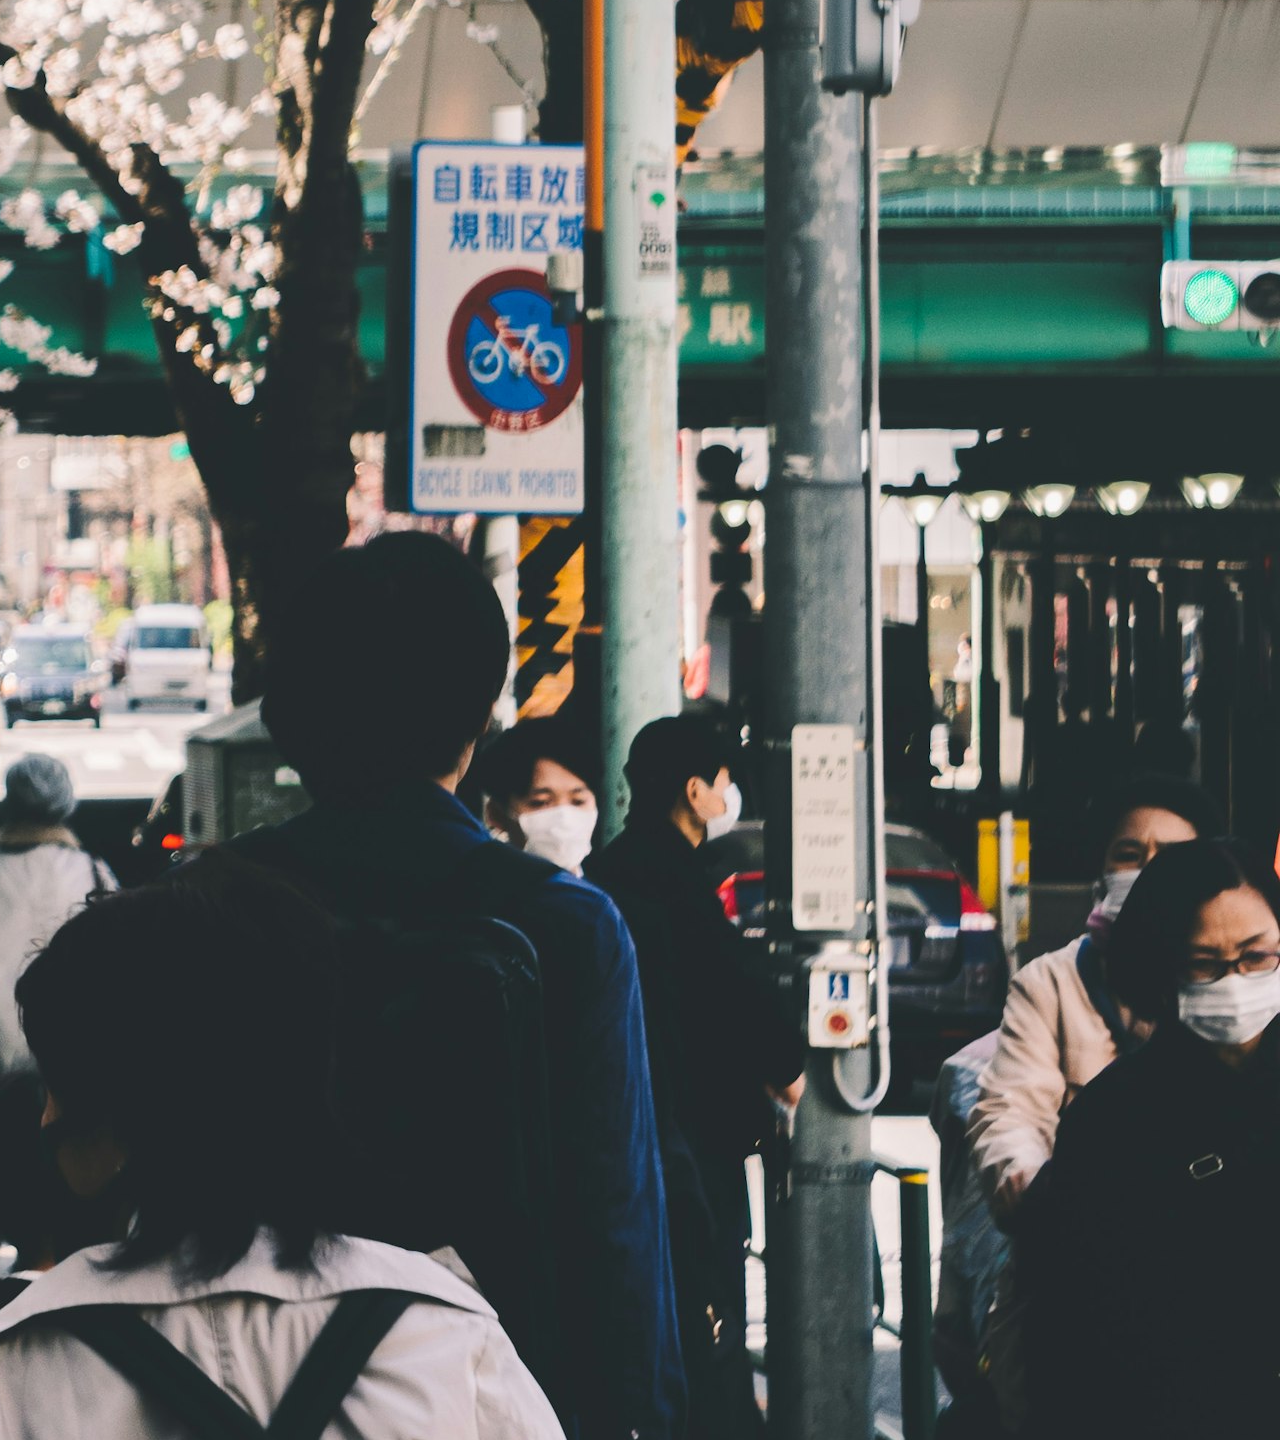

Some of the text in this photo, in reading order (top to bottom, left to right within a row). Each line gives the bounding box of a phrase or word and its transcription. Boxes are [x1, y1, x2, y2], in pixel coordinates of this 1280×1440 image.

[449, 209, 584, 252] 規制区域
[417, 467, 578, 499] BICYCLE LEAVING PROHIBITED
